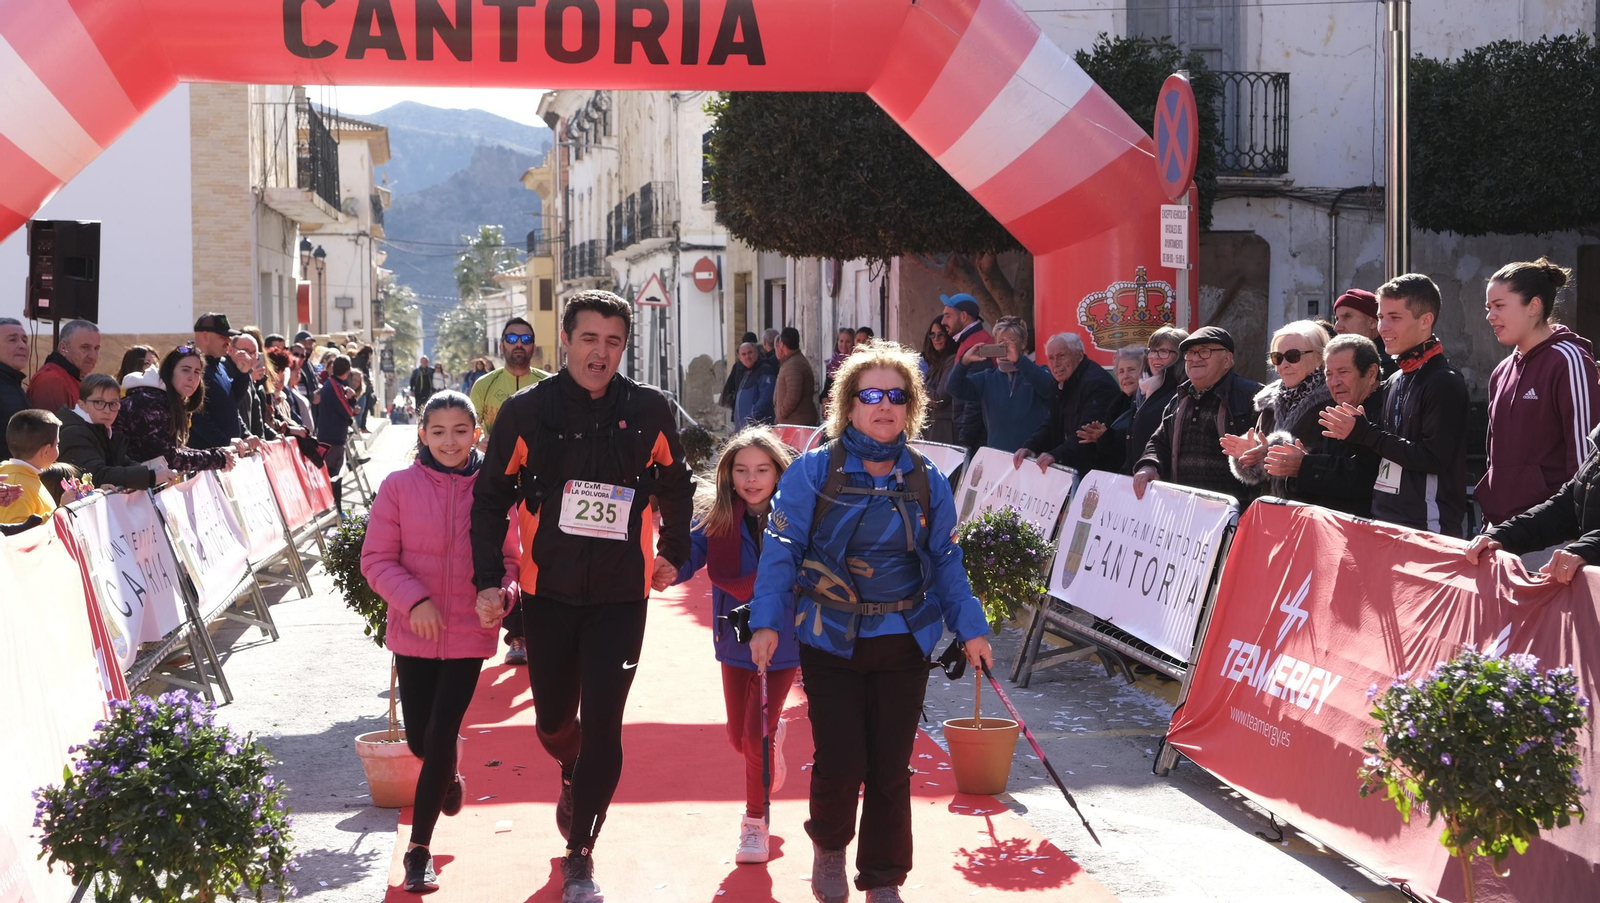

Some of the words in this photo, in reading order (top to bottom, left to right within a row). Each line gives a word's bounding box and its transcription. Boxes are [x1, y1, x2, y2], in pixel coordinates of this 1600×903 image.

[282, 0, 767, 65] CANTORIA
[574, 499, 616, 524] 235
[581, 488, 610, 498] PÓLVORA
[1040, 501, 1055, 520] DE
[1100, 511, 1190, 557] AYUNTAMIENTO
[1192, 540, 1208, 564] DE
[1084, 534, 1199, 618] CANTORIA
[1220, 638, 1343, 715] TEAMERGY
[1230, 706, 1291, 748] www.teamergy.es
